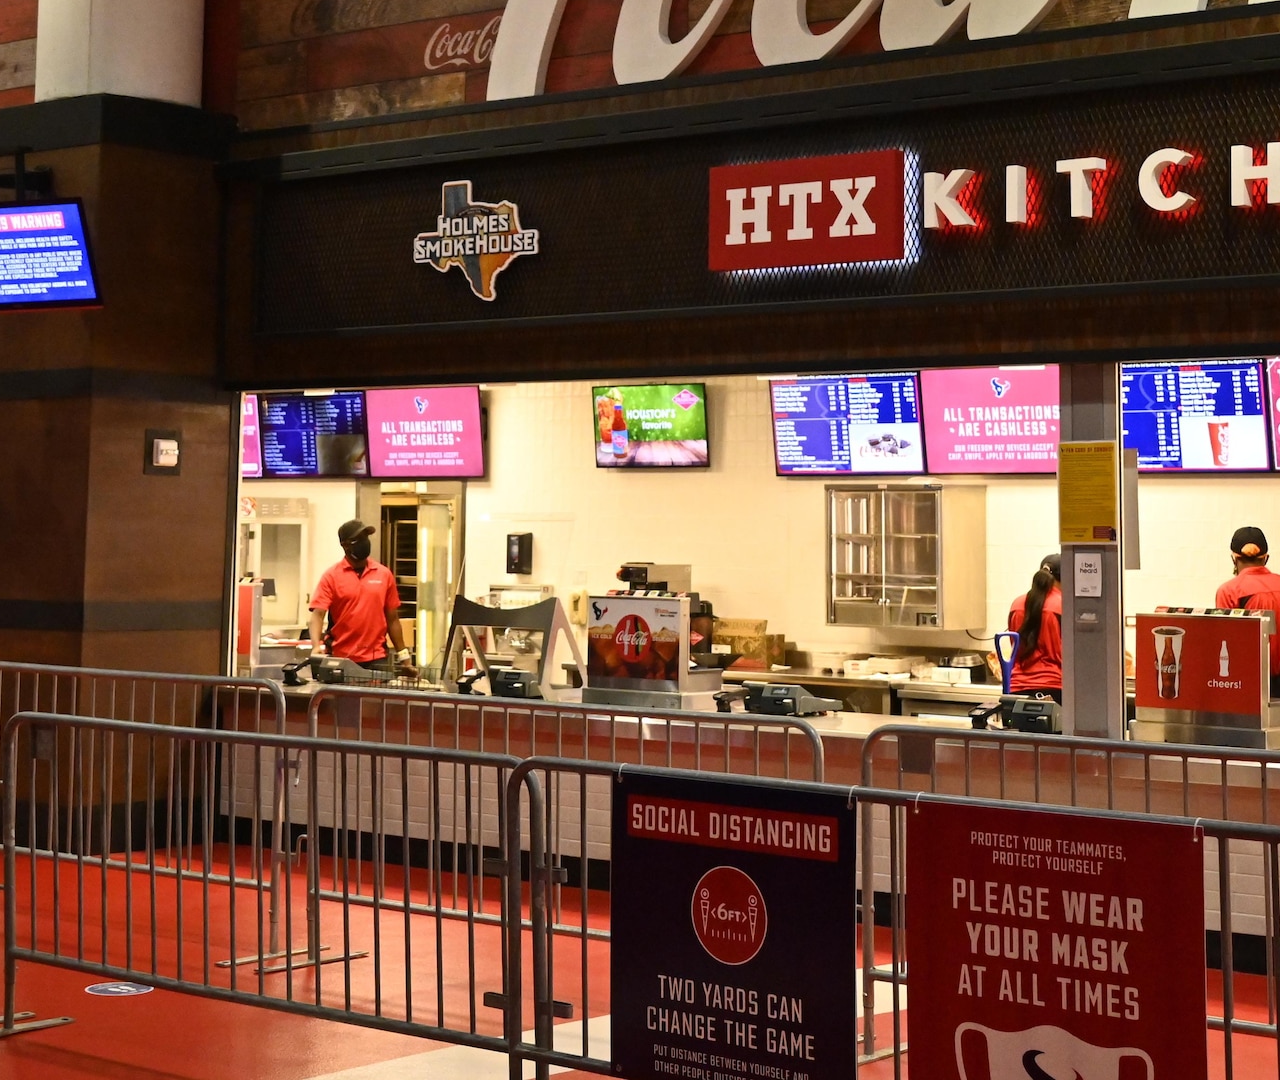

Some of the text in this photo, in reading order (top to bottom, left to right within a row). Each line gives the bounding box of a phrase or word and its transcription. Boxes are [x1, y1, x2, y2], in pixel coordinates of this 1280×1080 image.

[10, 213, 63, 230] WARNING
[724, 176, 877, 247] HTX
[438, 213, 510, 238] HOLMES
[415, 230, 536, 260] SMOKEHOUSE
[626, 408, 676, 421] HOUSTON'S
[642, 420, 672, 430] favorite
[944, 405, 1060, 422] ALL TRANSACTIONS
[382, 420, 463, 433] ALL TRANSACTIONS
[958, 421, 1047, 437] ARE CASHLESS
[392, 433, 454, 446] ARE CASHLESS
[986, 452, 1003, 460] APPLE
[616, 631, 648, 645] Coca-Cola
[1207, 678, 1242, 689] cheers!
[632, 803, 831, 853] SOCIAL DISTANCING
[970, 831, 1127, 862] PROTECT YOUR TEAMMATES,
[992, 850, 1104, 876] PROTECT YOURSELF
[952, 877, 1144, 932] PLEASE WEAR
[965, 921, 1129, 975] YOUR MASK
[658, 974, 802, 1024] TWO YARDS CAN
[957, 964, 1140, 1021] AT ALL TIMES
[646, 1006, 816, 1061] CHANGE THE GAME
[653, 1044, 668, 1056] PUT
[670, 1047, 708, 1065] DISTANCE
[710, 1054, 747, 1072] BETWEEN
[749, 1062, 790, 1080] YOURSELF
[654, 1060, 711, 1080] OTHER PEOPLE
